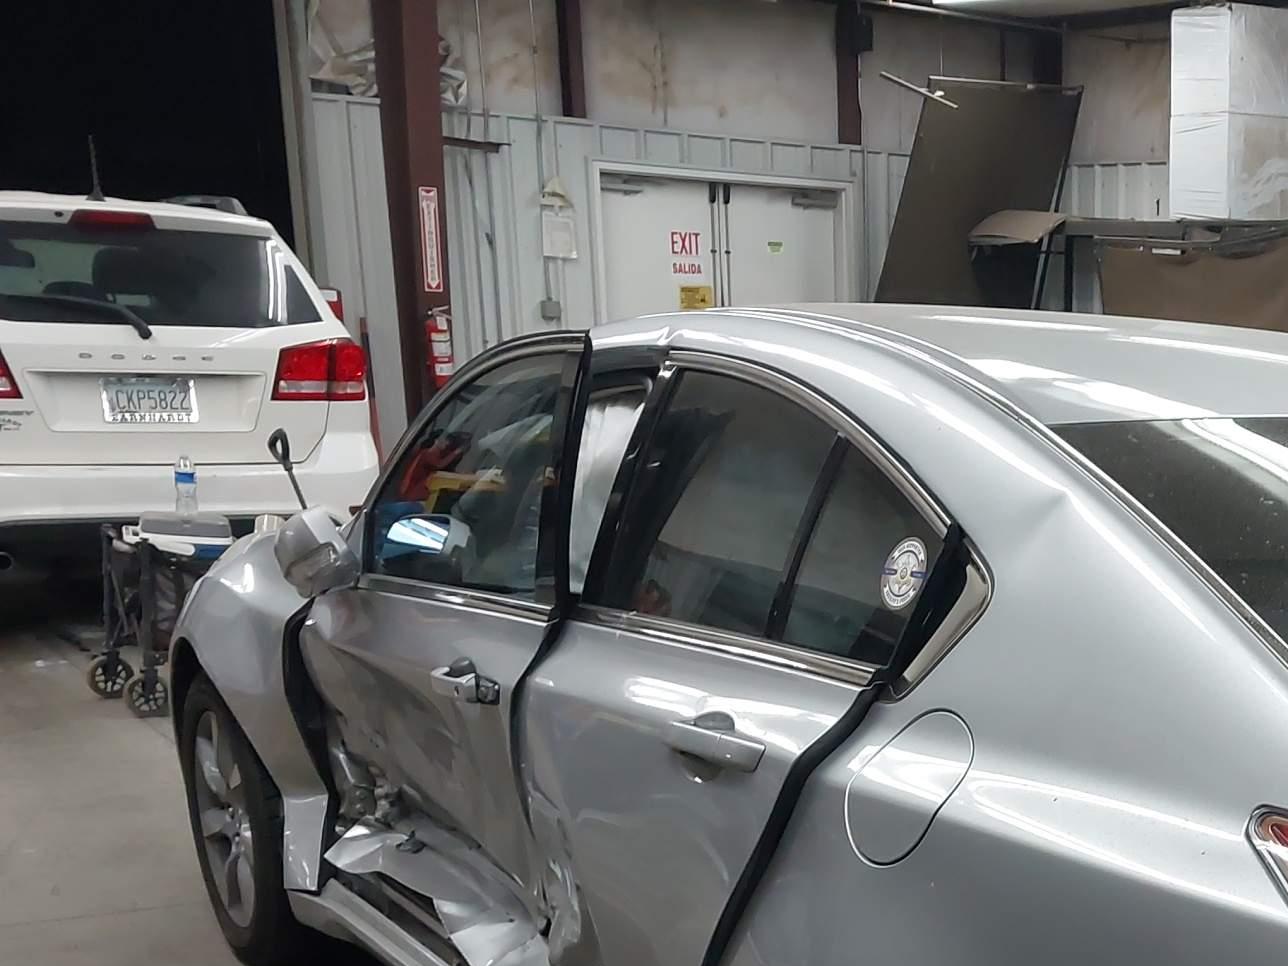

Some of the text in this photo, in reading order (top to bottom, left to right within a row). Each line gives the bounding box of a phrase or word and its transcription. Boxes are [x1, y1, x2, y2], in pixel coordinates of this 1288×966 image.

[670, 231, 701, 256] EXIT
[672, 262, 702, 275] SALIDA
[115, 390, 190, 410] CKP5822
